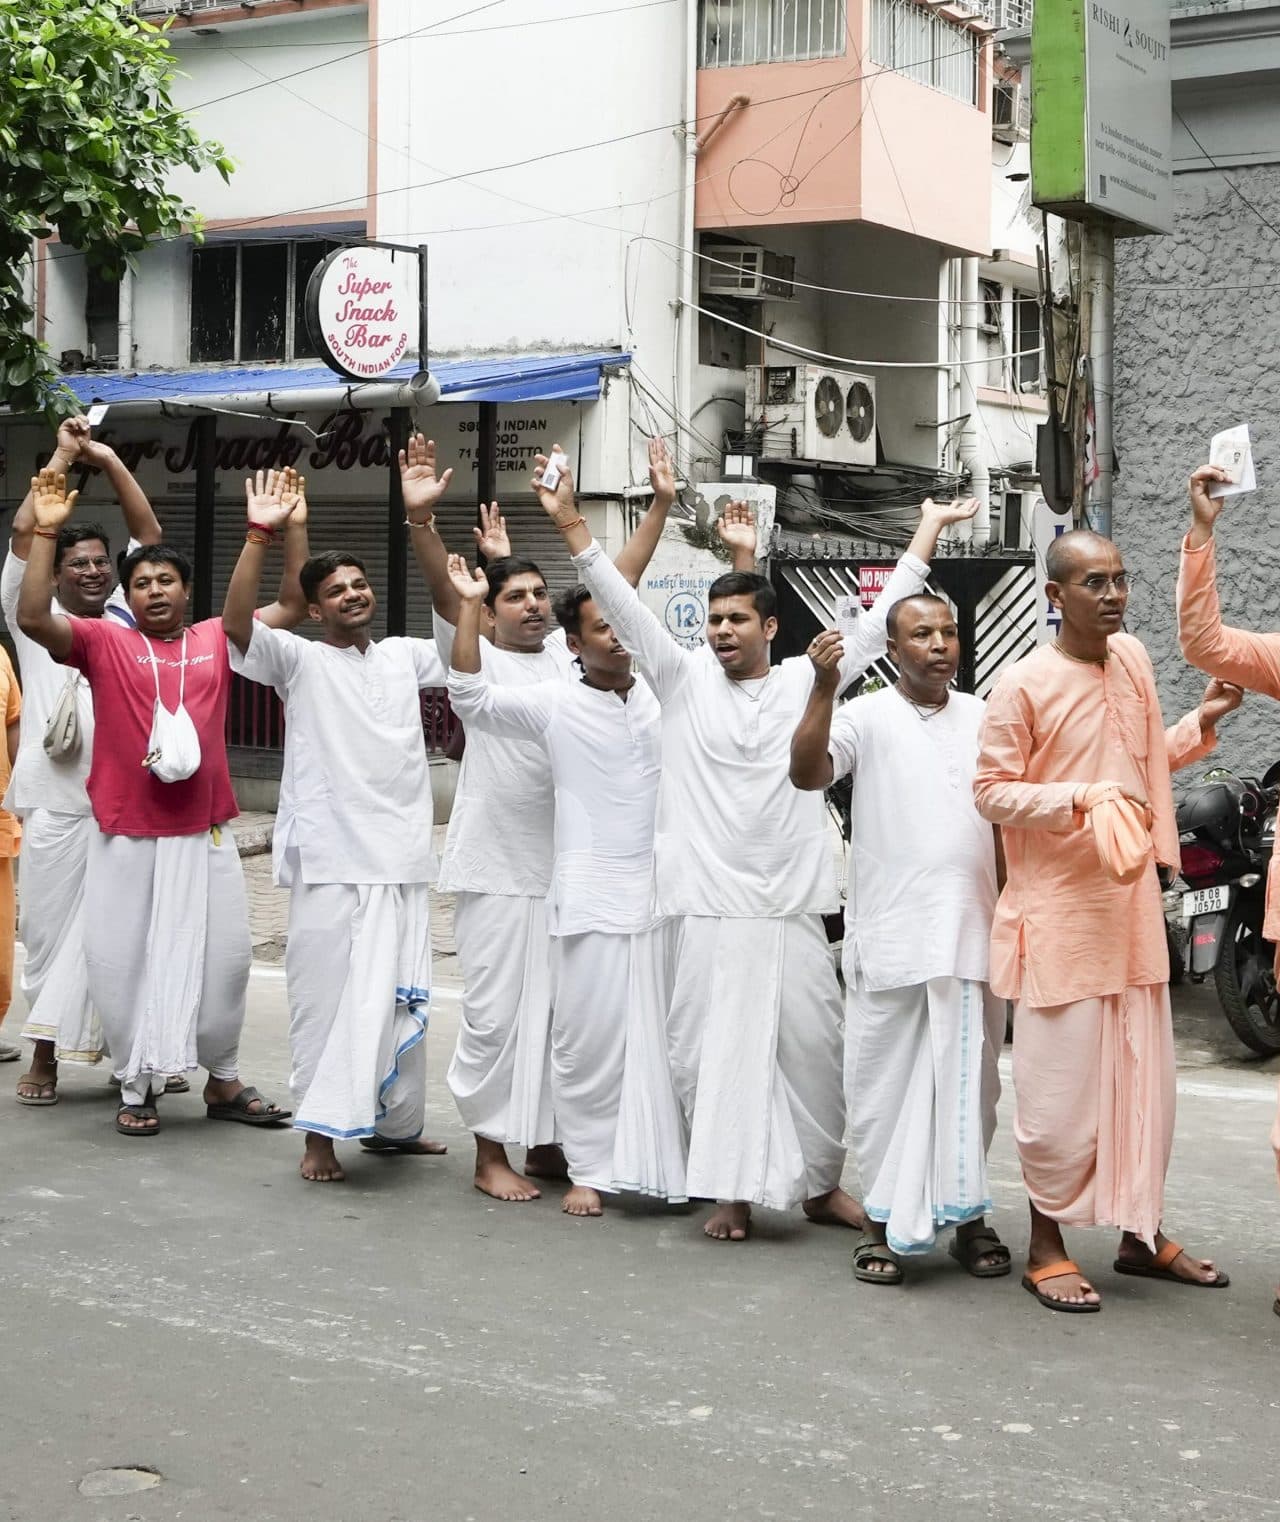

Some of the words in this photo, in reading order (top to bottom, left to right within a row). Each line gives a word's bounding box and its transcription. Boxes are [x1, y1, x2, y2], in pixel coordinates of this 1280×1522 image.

[1092, 3, 1120, 34] RISHI
[1135, 29, 1167, 61] SOUJIT
[342, 257, 359, 270] The
[338, 273, 393, 302] Super
[336, 299, 398, 322] Snack
[344, 324, 393, 348] Bar
[328, 333, 356, 370] SOUTH
[358, 359, 391, 374] INDIAN
[391, 332, 408, 363] FOOD
[504, 419, 547, 431] INDIAN
[458, 448, 471, 459] 71
[679, 579, 715, 589] BUILDIN
[861, 570, 873, 588] NO
[674, 604, 696, 628] 12
[1208, 887, 1220, 900] 08
[1192, 898, 1221, 914] J0570
